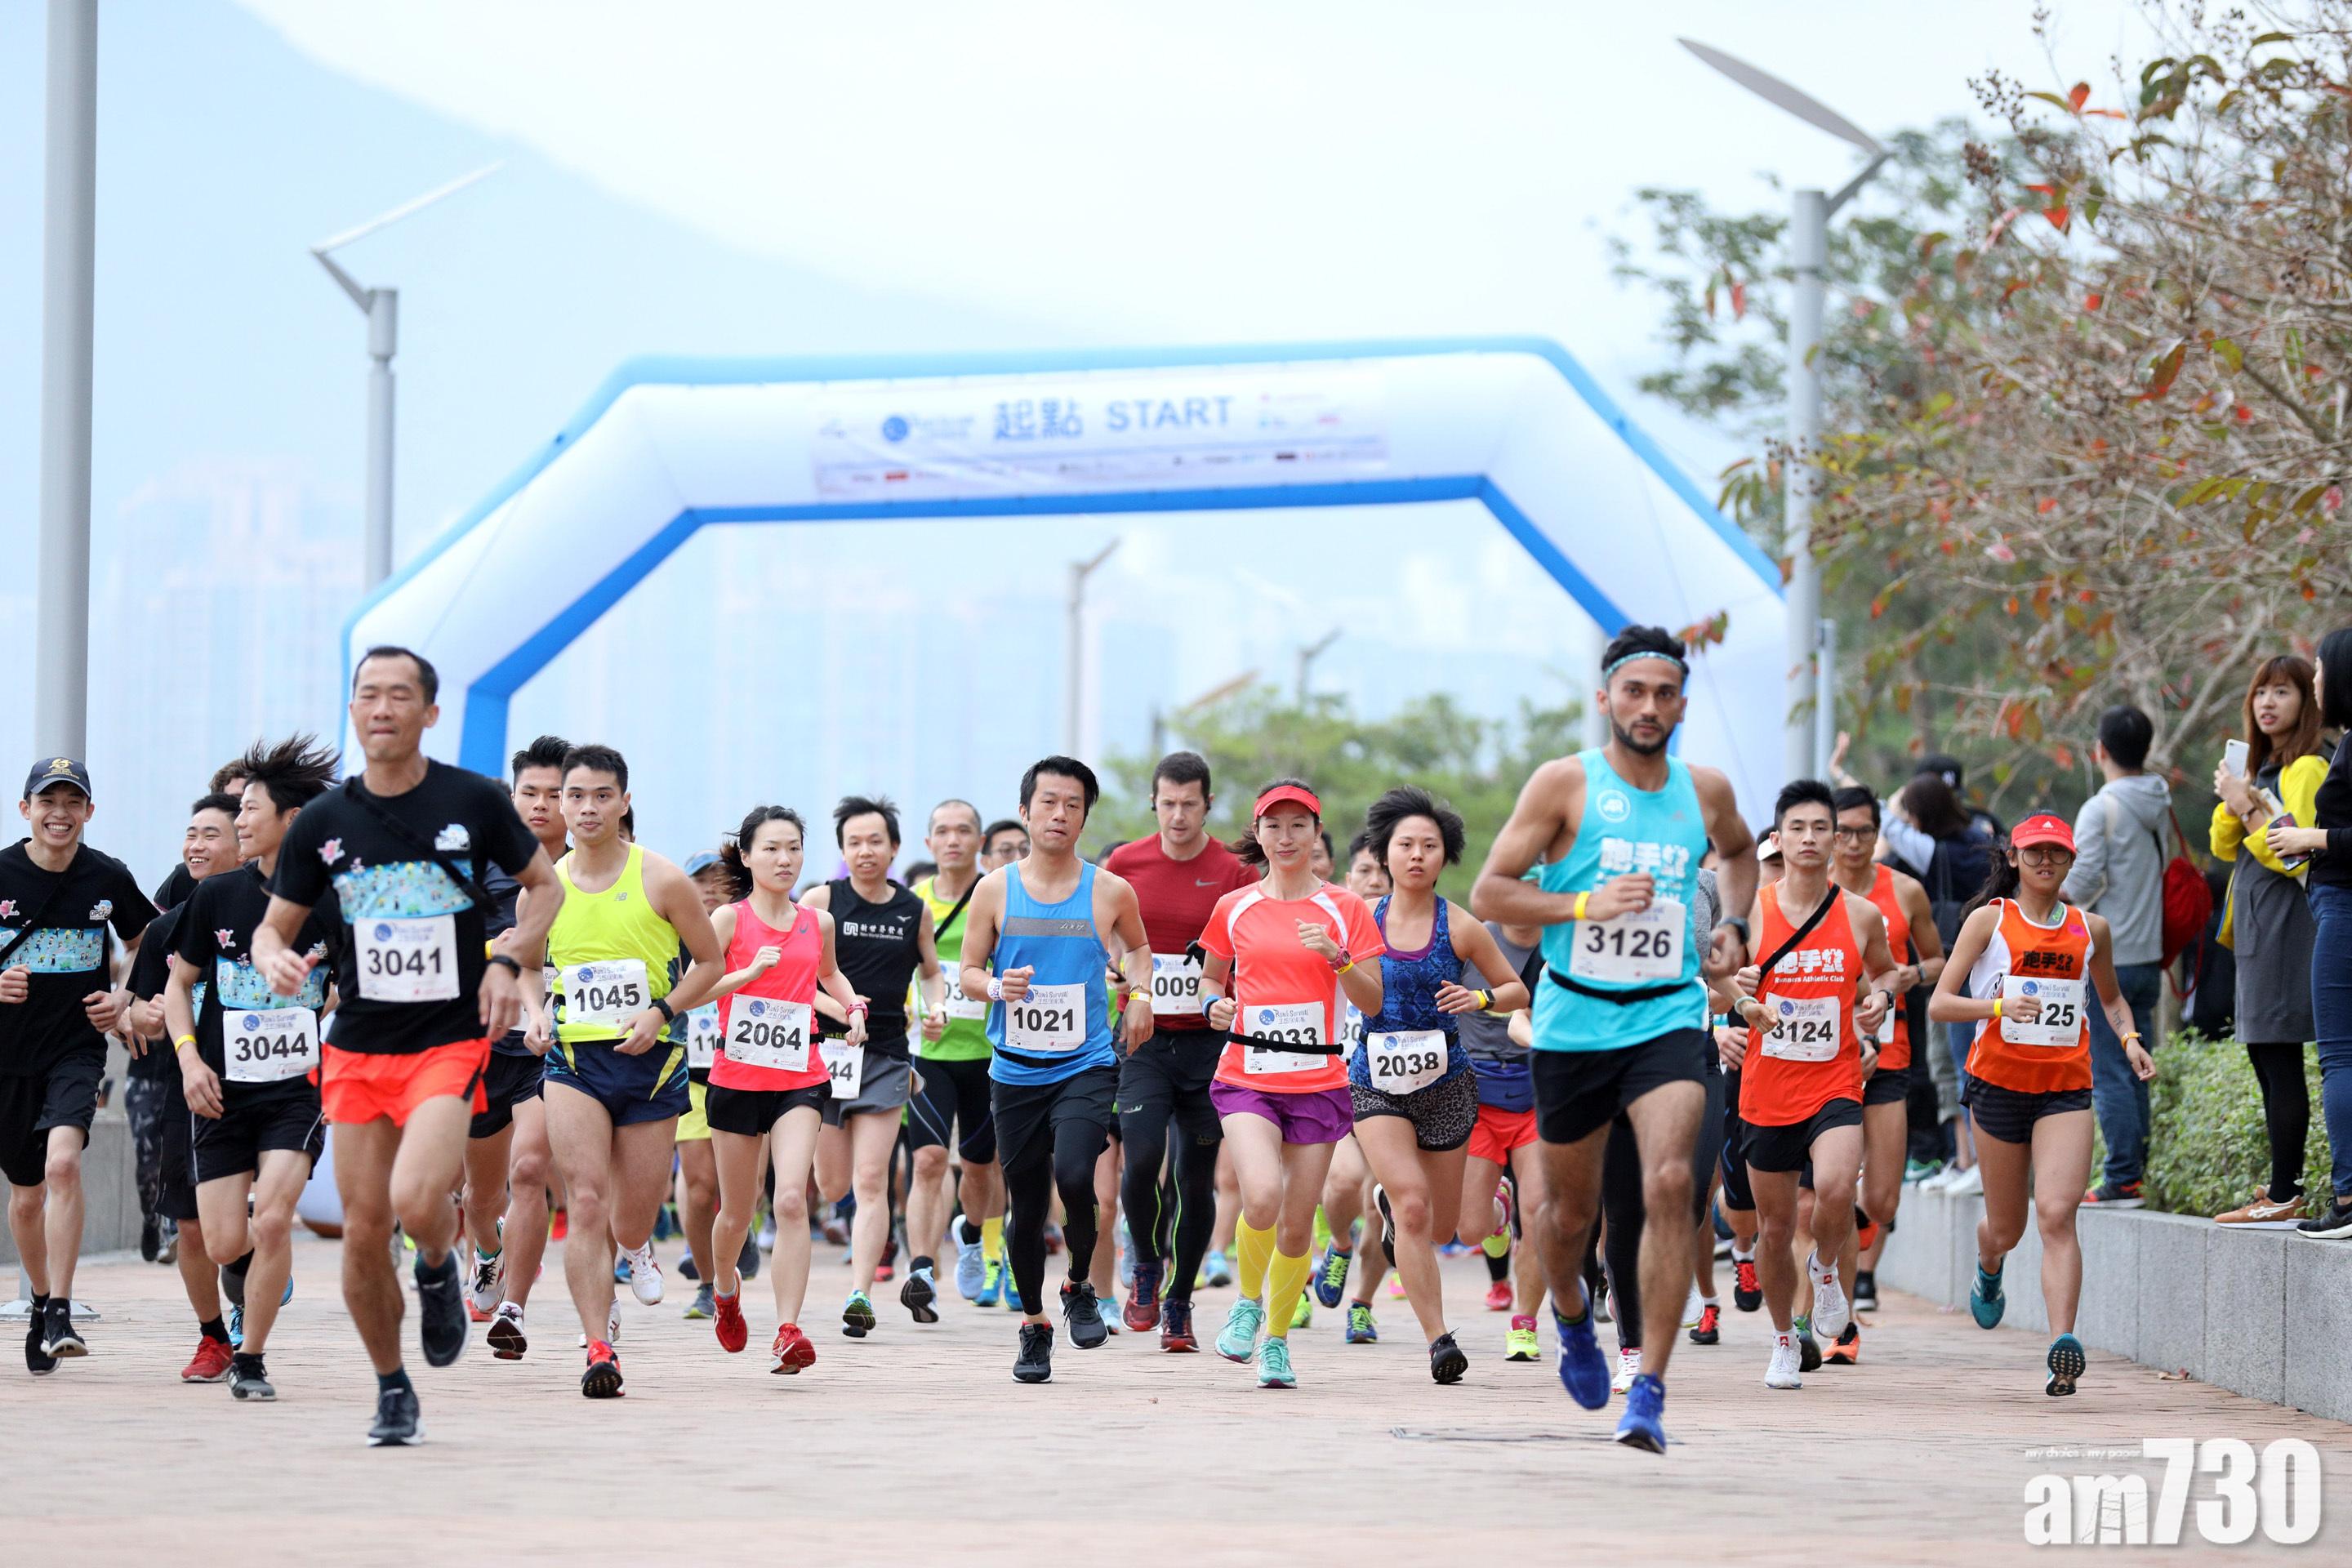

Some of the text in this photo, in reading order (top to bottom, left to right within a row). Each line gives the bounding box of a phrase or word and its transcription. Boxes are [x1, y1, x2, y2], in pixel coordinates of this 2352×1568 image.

[993, 398, 1083, 441] 起點
[1107, 395, 1232, 432] START
[1586, 925, 1671, 958] 3126
[368, 947, 441, 976] 3041
[574, 983, 640, 1012] 1045
[1014, 1007, 1073, 1031] 1021
[1771, 1019, 1833, 1043] 3124
[235, 1032, 309, 1062] 3044
[735, 1020, 801, 1050] 2064
[1253, 1027, 1317, 1054] 2033
[1377, 1052, 1439, 1076] 2038
